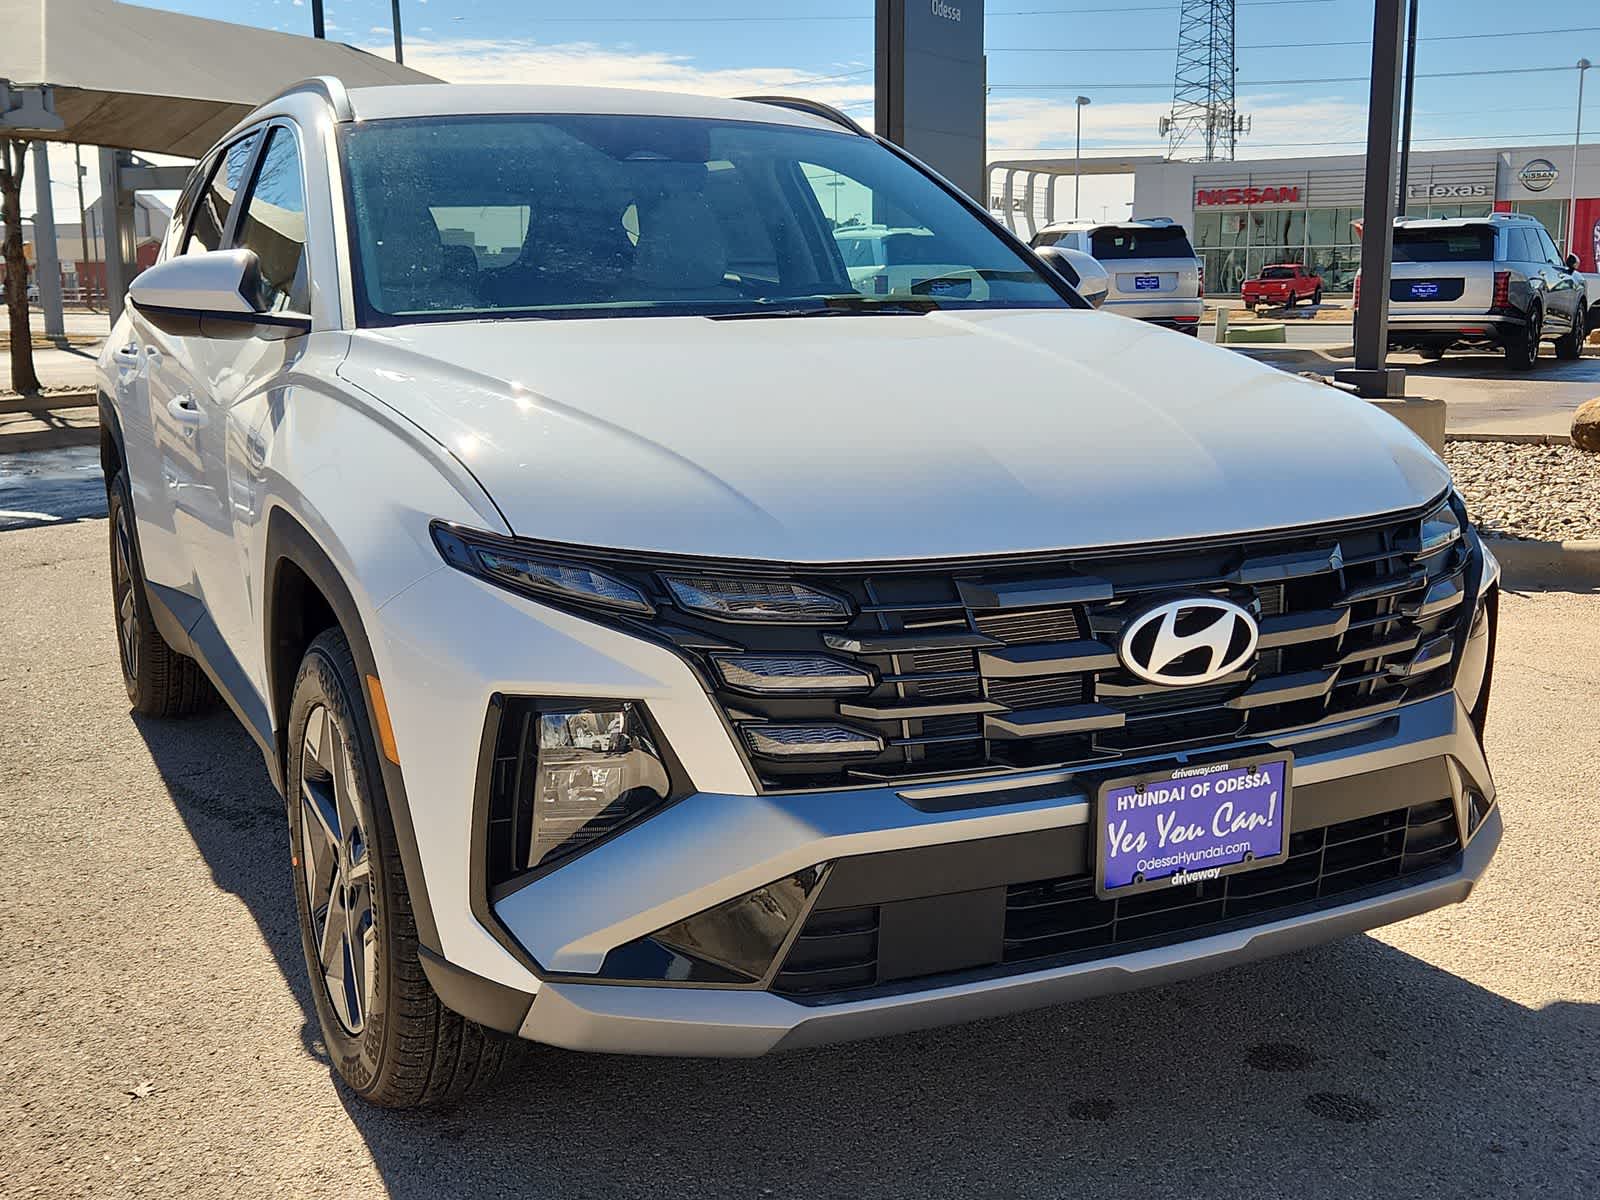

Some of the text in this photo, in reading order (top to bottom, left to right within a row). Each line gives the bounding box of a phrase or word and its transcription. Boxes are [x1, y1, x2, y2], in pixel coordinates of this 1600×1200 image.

[931, 0, 961, 21] Odessa
[1197, 186, 1299, 206] NISSAN
[1424, 183, 1486, 197] Texas
[1171, 763, 1229, 779] driveway.com
[1117, 772, 1271, 811] HYUNDAI OF ODESSA
[1107, 791, 1278, 858] Yes You Can!
[1136, 841, 1250, 873] OdessaHyundai.com
[1171, 867, 1221, 886] driveway
